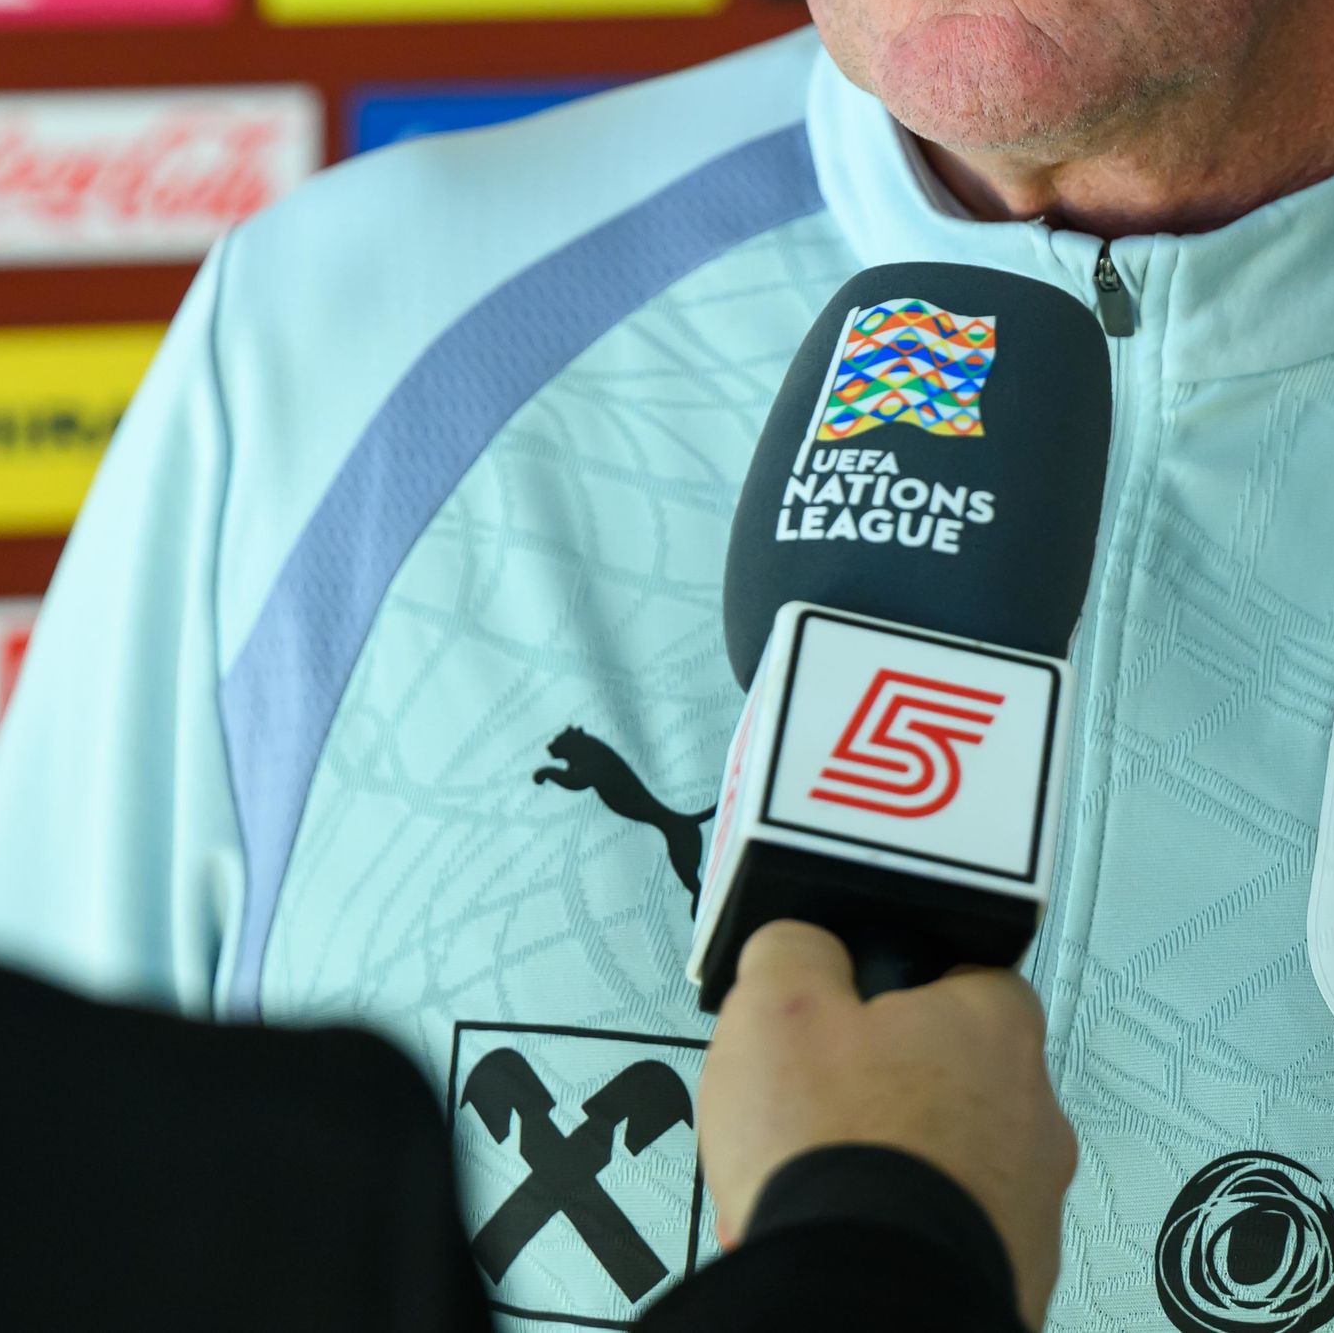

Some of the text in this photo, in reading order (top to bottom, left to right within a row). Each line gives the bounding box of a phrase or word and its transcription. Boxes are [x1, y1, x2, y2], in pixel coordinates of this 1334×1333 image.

[811, 448, 899, 476] UEFA
[783, 472, 996, 525] NATIONS
[776, 507, 963, 556] LEAGUE
